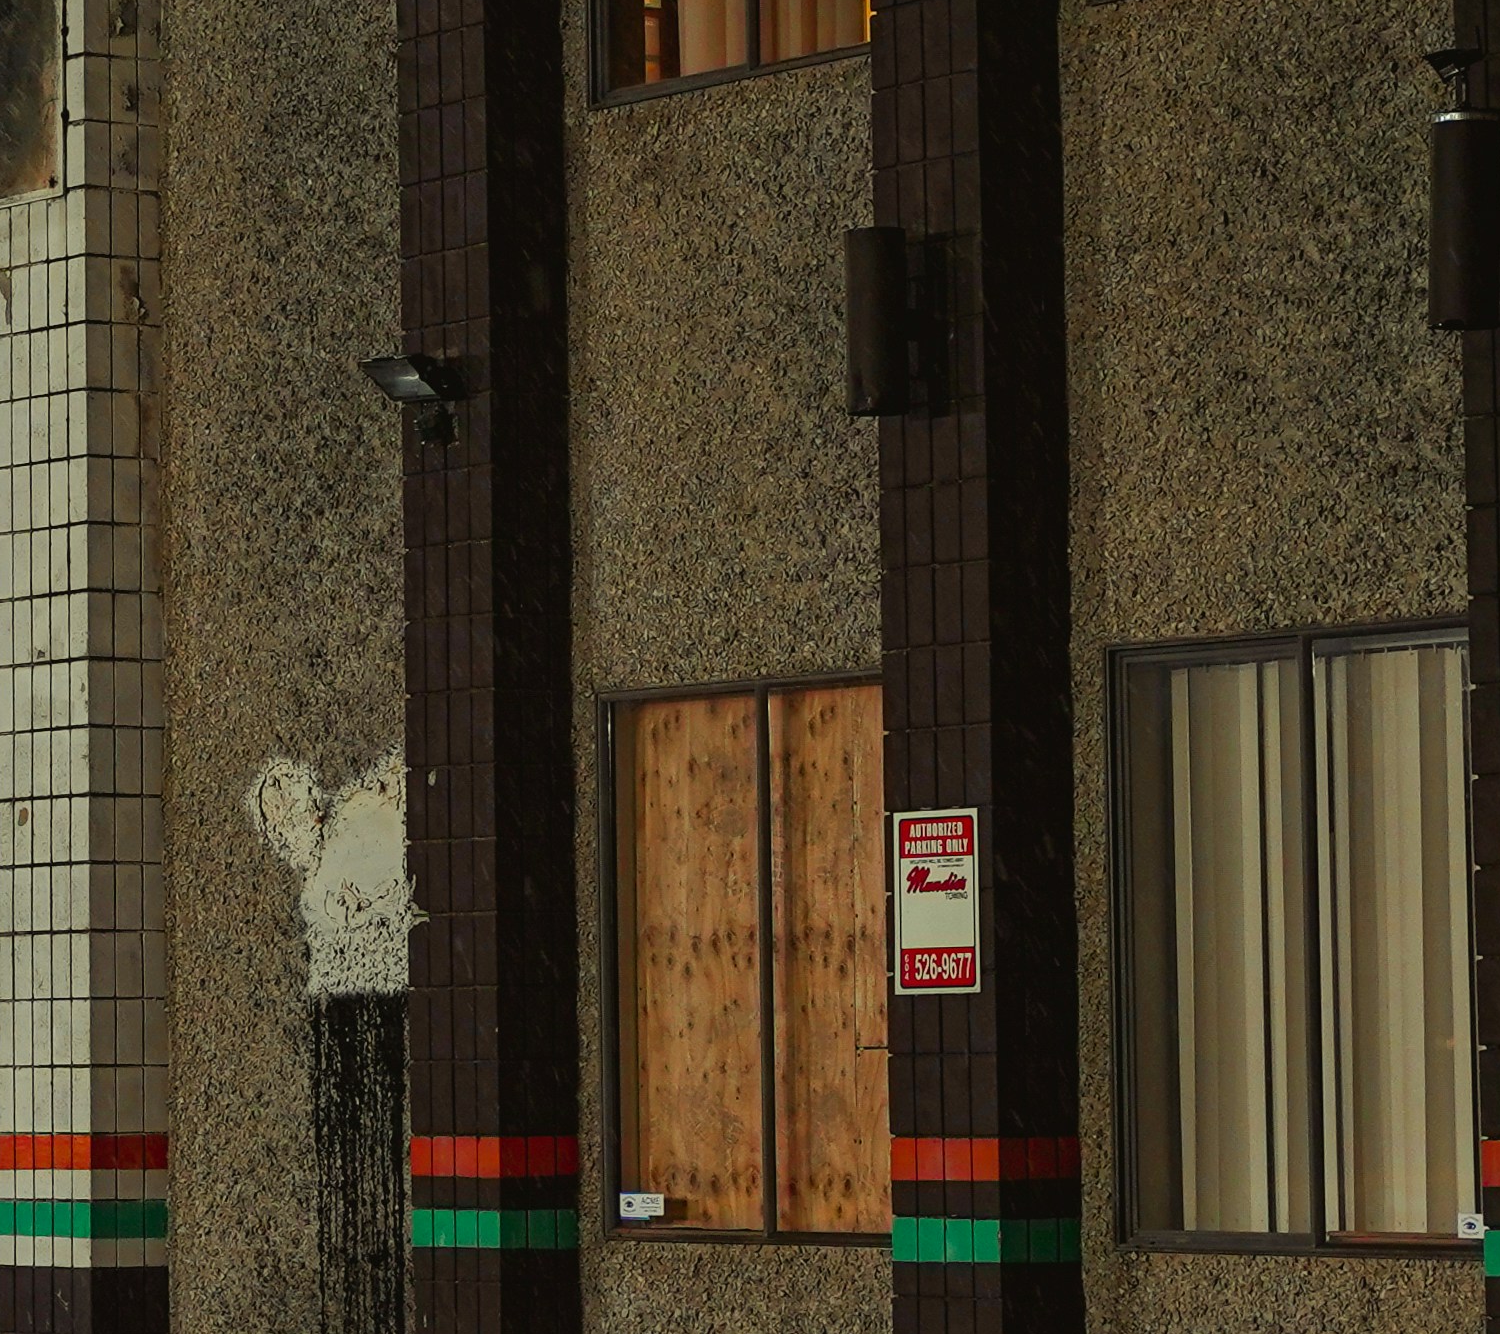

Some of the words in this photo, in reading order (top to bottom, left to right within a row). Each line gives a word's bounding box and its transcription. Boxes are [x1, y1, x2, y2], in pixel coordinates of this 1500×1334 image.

[909, 821, 963, 838] AUTHORIZED
[904, 839, 943, 855] PARKING
[945, 838, 969, 853] ONLY
[914, 952, 973, 981] 526-9677
